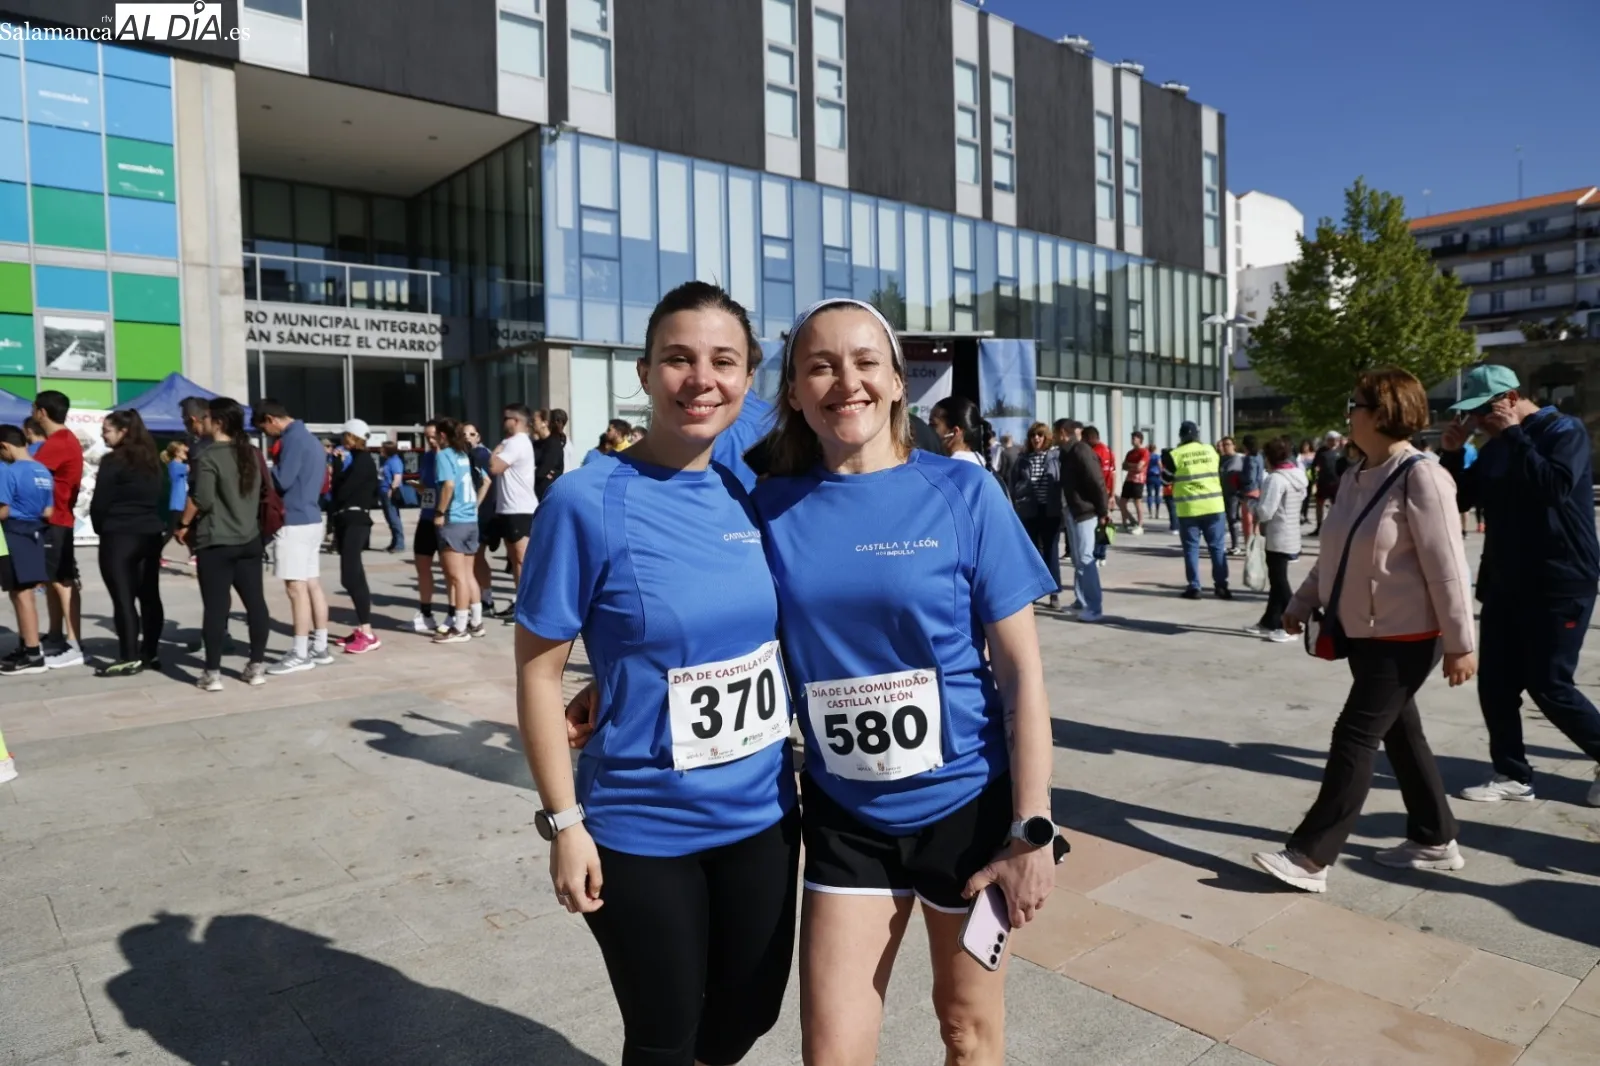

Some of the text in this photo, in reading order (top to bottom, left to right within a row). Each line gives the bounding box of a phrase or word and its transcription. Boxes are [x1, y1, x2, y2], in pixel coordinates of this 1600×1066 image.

[273, 312, 360, 330] MUNICIPAL
[365, 318, 450, 336] INTEGRADO
[276, 328, 351, 348] SÁNCHEZ
[357, 336, 372, 349] EL
[855, 537, 939, 552] CASTILLA Y LEÓN
[696, 671, 712, 681] DE
[715, 659, 759, 679] CASTILLA
[812, 675, 929, 698] DÍA DE LA COMUNIDAD
[690, 668, 776, 739] 370
[827, 690, 914, 709] CASTILLA Y LEÓN
[824, 704, 928, 756] 580
